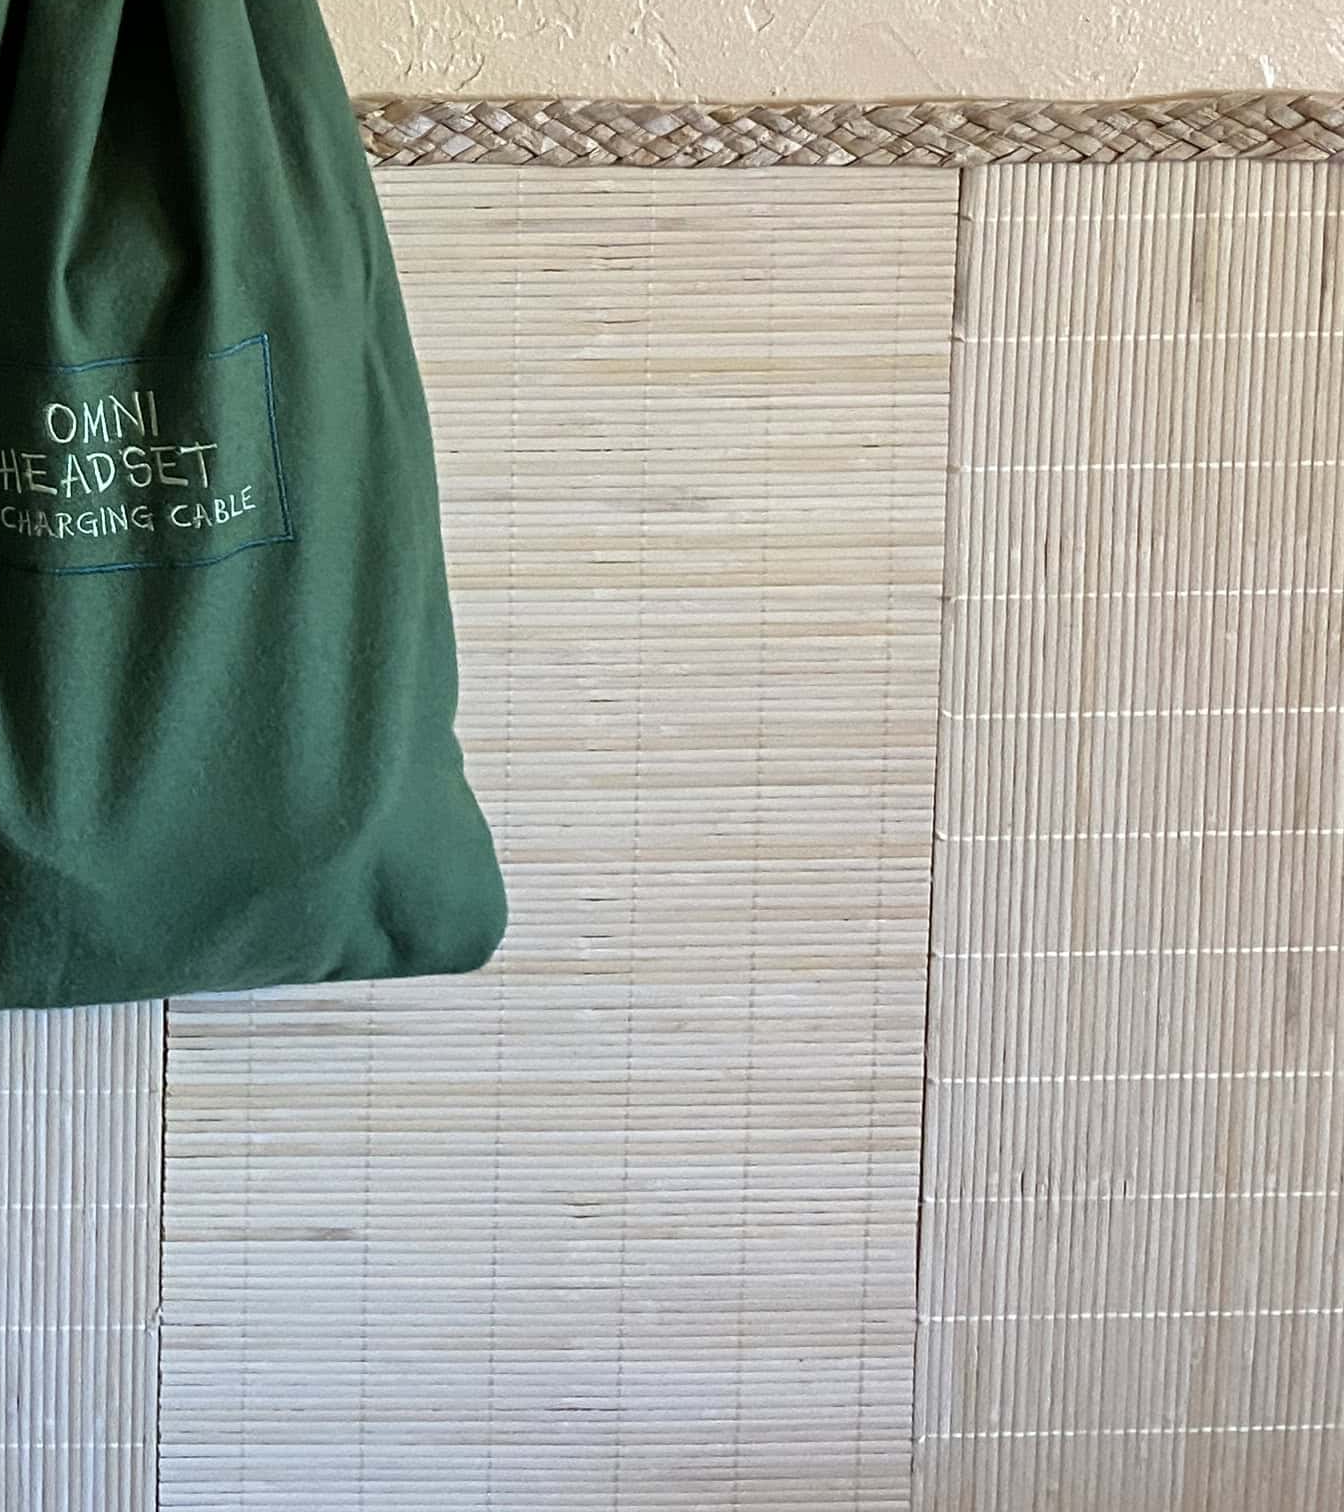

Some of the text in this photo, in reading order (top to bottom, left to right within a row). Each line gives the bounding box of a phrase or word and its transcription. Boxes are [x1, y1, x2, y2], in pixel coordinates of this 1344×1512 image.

[47, 391, 158, 444] OMNI
[1, 504, 154, 538] CHARGING
[171, 485, 256, 529] CABLE
